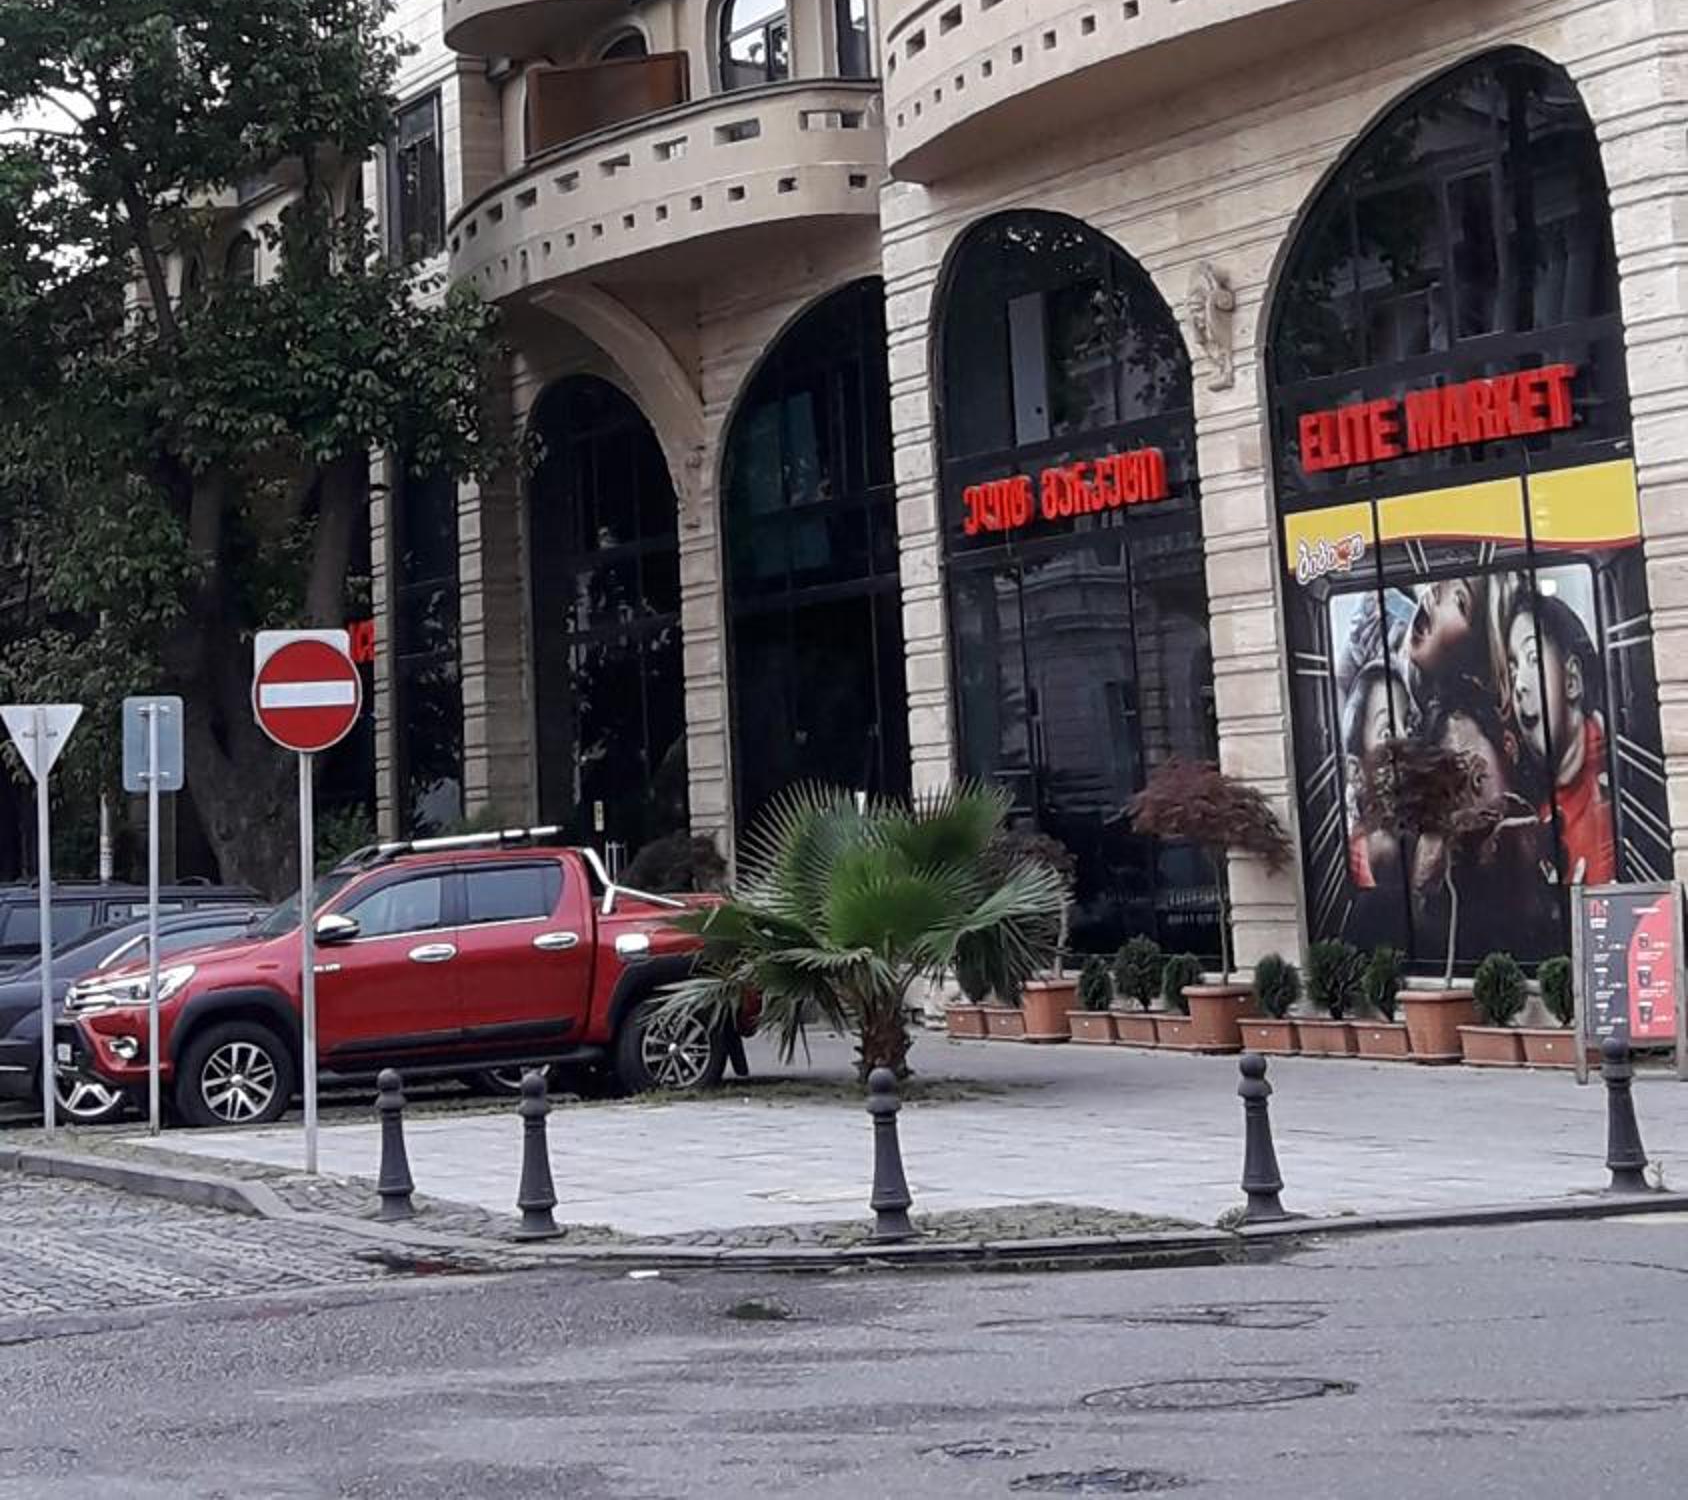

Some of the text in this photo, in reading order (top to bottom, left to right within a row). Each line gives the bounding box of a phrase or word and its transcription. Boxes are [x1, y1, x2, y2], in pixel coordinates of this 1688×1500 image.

[1299, 363, 1577, 474] ELITE MARKET
[963, 446, 1167, 536] ელიტ მარკეტი
